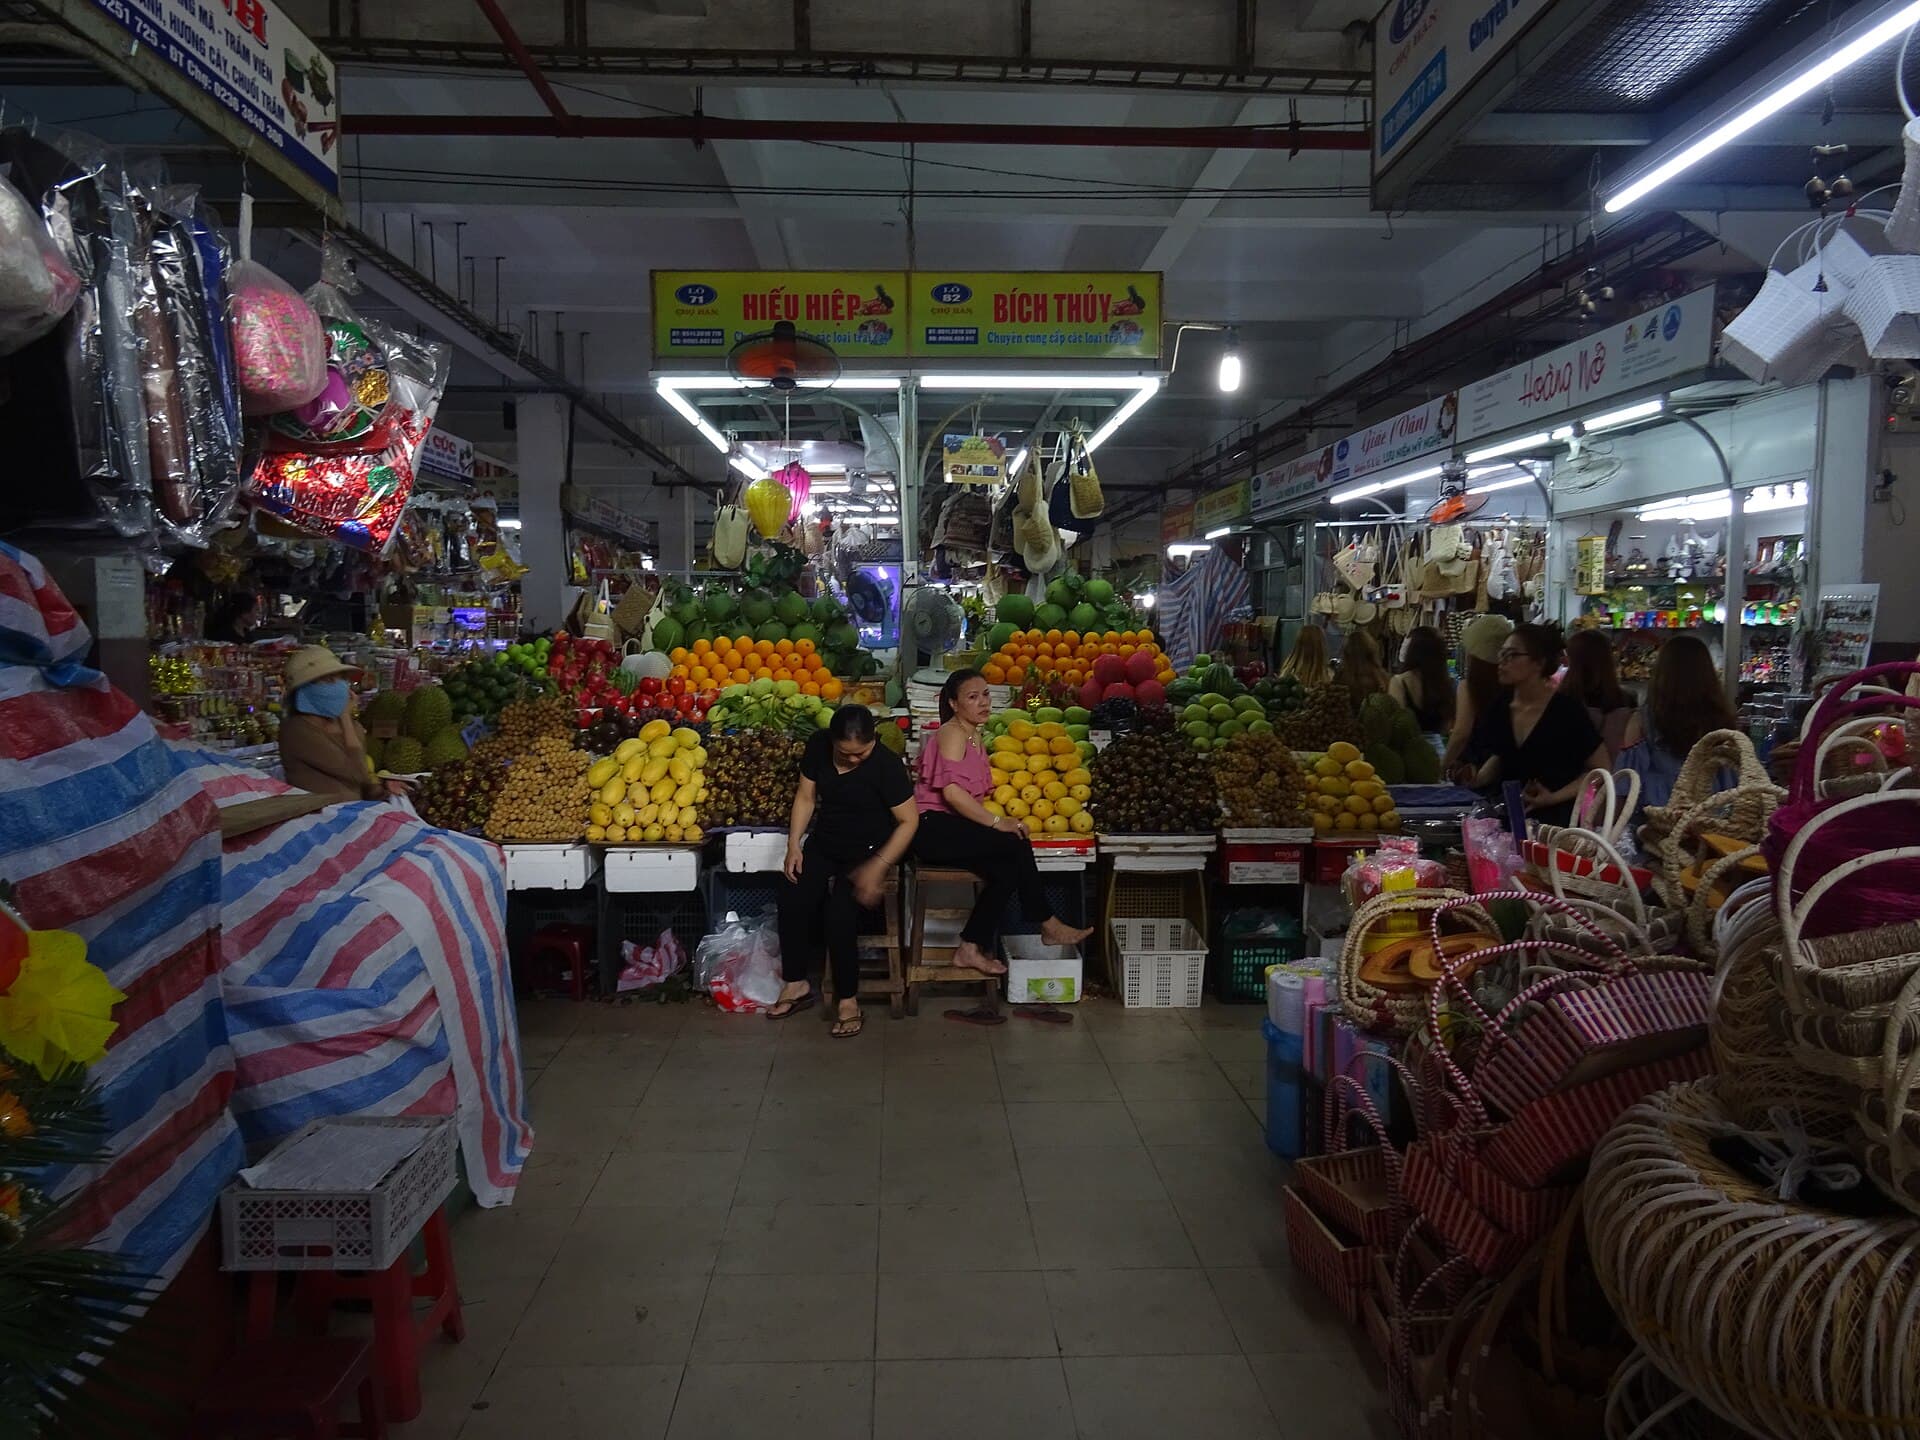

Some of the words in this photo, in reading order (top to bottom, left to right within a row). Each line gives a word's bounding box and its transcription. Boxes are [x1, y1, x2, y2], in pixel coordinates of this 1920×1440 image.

[135, 16, 158, 47] 725
[688, 295, 704, 304] 71
[742, 285, 799, 321] HIẾU
[805, 288, 861, 326] HIỆP
[942, 294, 961, 303] 82
[993, 287, 1048, 324] BÍCH
[1053, 284, 1112, 324] THỦY
[1025, 333, 1048, 346] cung
[1518, 358, 1573, 409] Hoàng
